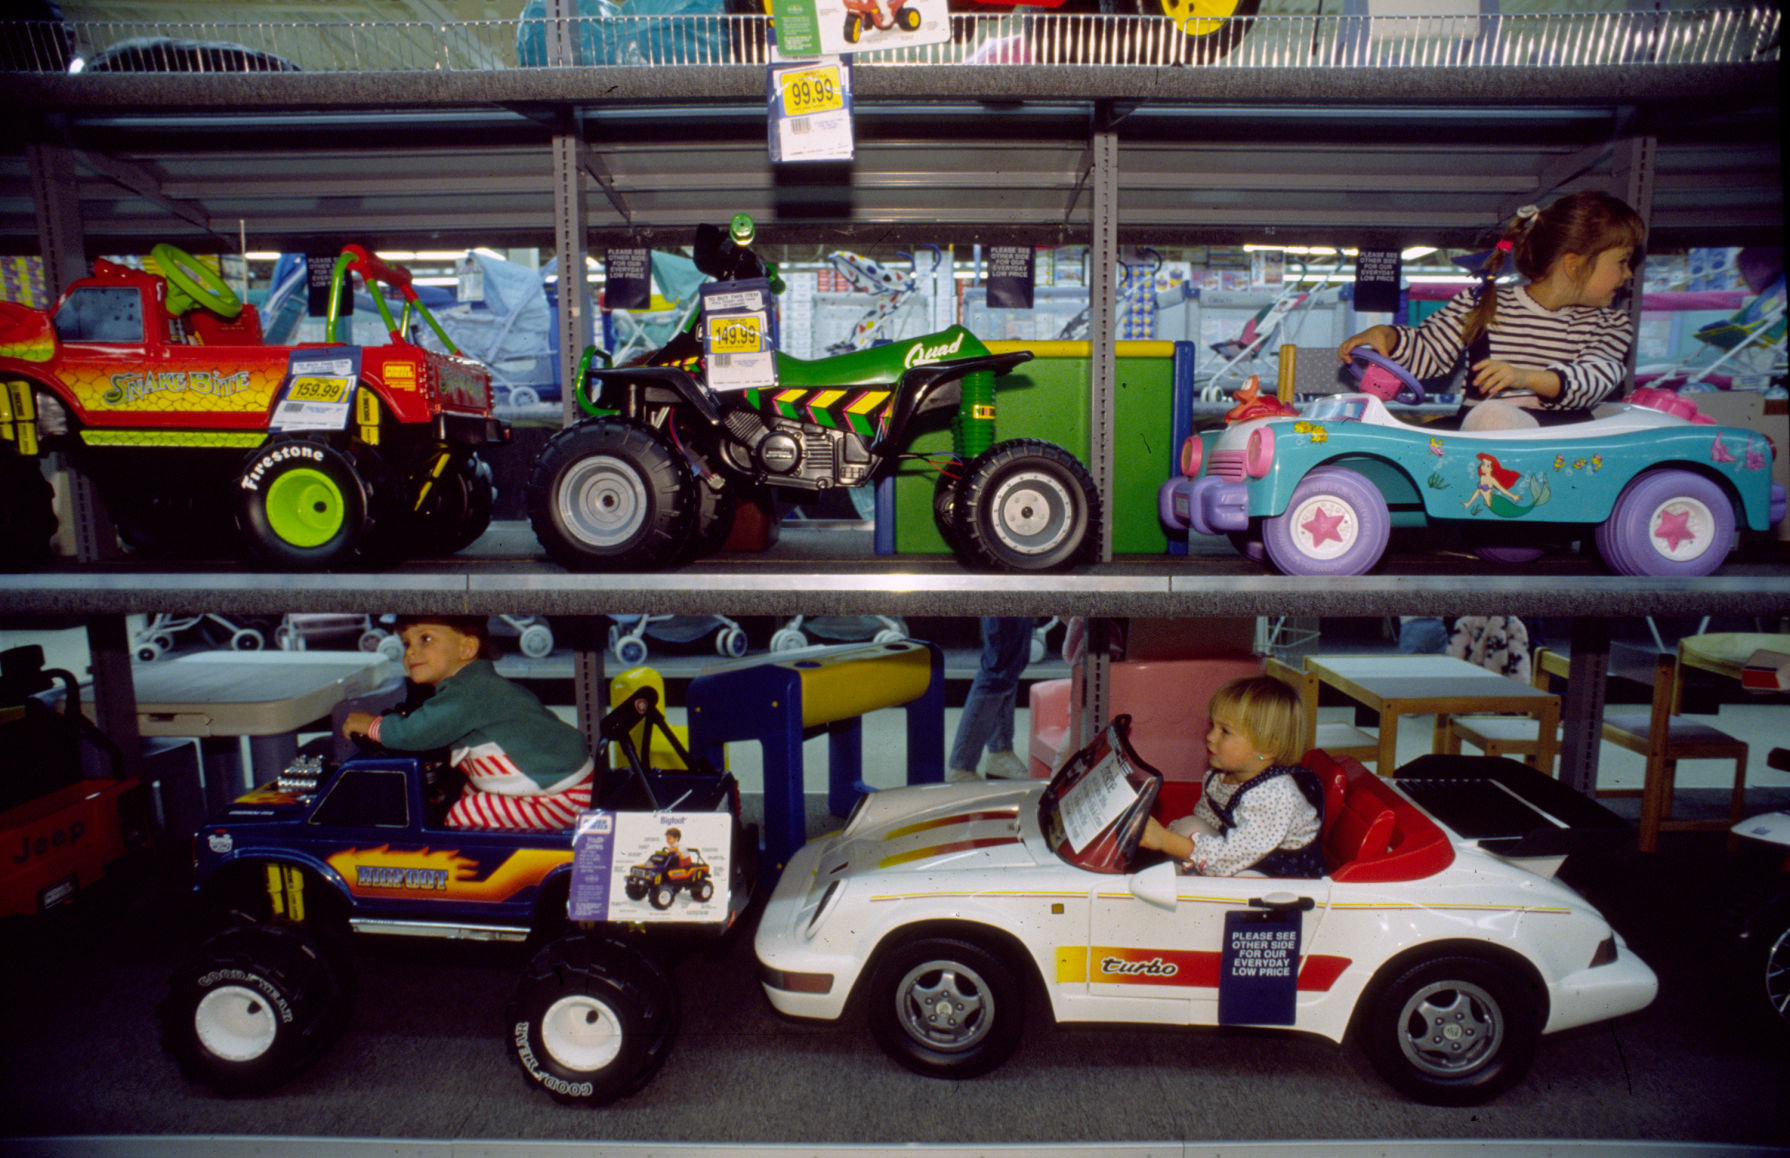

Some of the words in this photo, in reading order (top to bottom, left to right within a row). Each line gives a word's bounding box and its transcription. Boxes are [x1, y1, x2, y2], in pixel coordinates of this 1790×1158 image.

[792, 78, 834, 106] 99.99
[715, 325, 756, 346] 149.99
[905, 332, 964, 369] Quad
[104, 370, 187, 405] SNAKE
[296, 383, 340, 398] 159.99
[241, 446, 324, 491] Firestone
[12, 821, 85, 864] Jeep
[356, 865, 448, 891] BIGFOOT
[1232, 931, 1273, 940] PLEASE
[1276, 931, 1297, 940] SEE
[1232, 941, 1268, 949] OTHER
[1270, 941, 1295, 949] SIDE
[1233, 958, 1290, 967] EVERYDAY
[1239, 950, 1261, 958] FOR
[1263, 950, 1287, 958] OUR
[1101, 956, 1178, 976] turbo
[1232, 967, 1257, 976] LOW
[1259, 967, 1290, 976] PRICE
